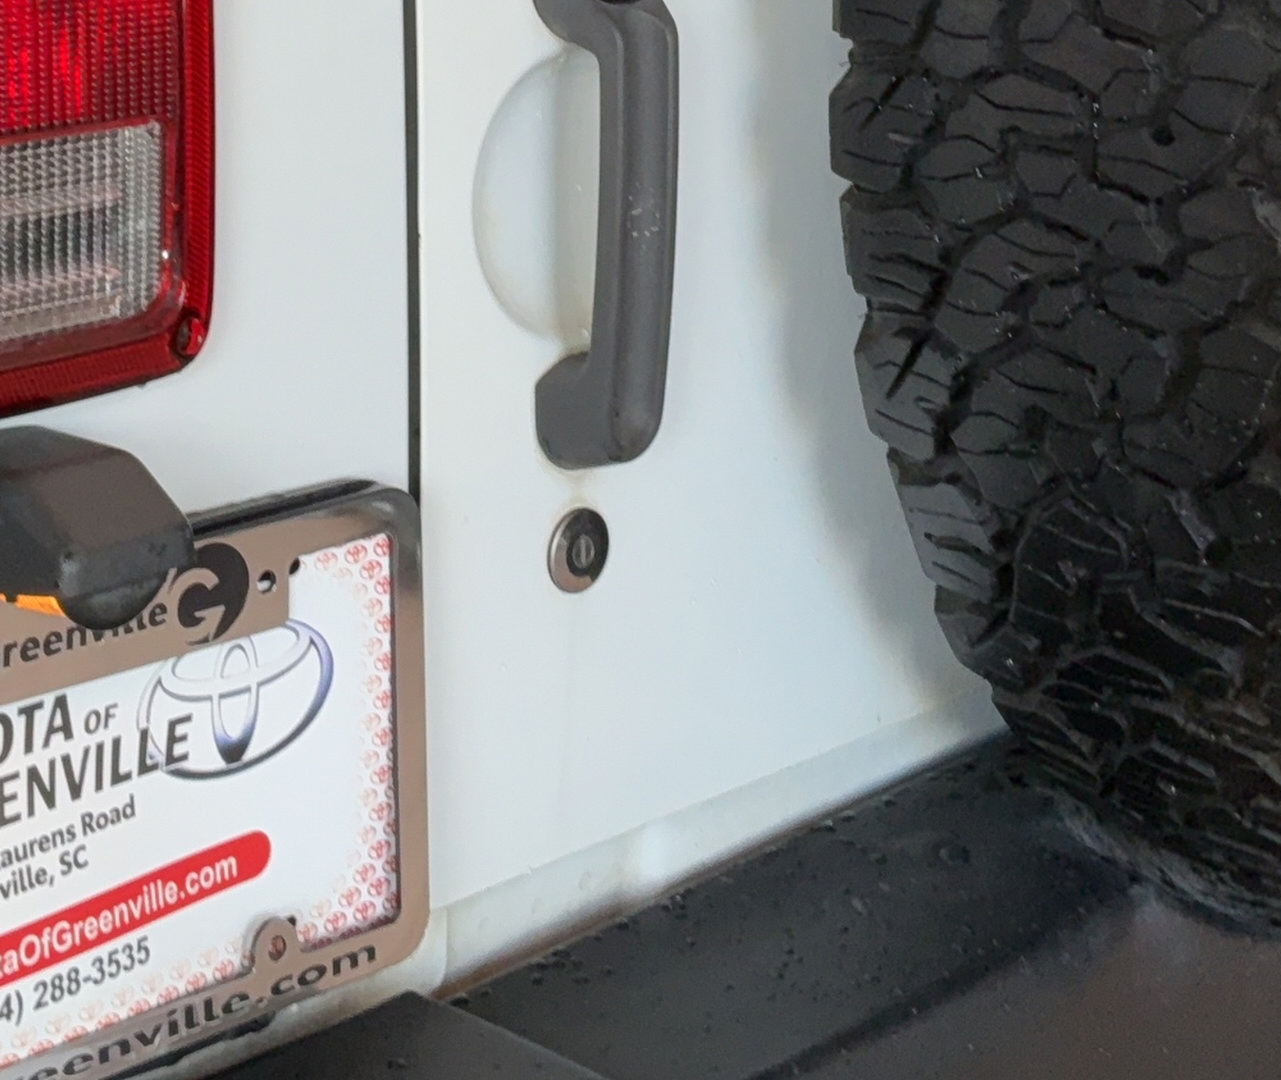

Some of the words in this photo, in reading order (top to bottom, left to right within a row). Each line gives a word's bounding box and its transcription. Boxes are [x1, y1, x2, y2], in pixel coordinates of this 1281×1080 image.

[83, 703, 118, 736] OF
[81, 793, 136, 838] Road
[59, 844, 89, 876] SC
[32, 935, 151, 1014] 288-3535
